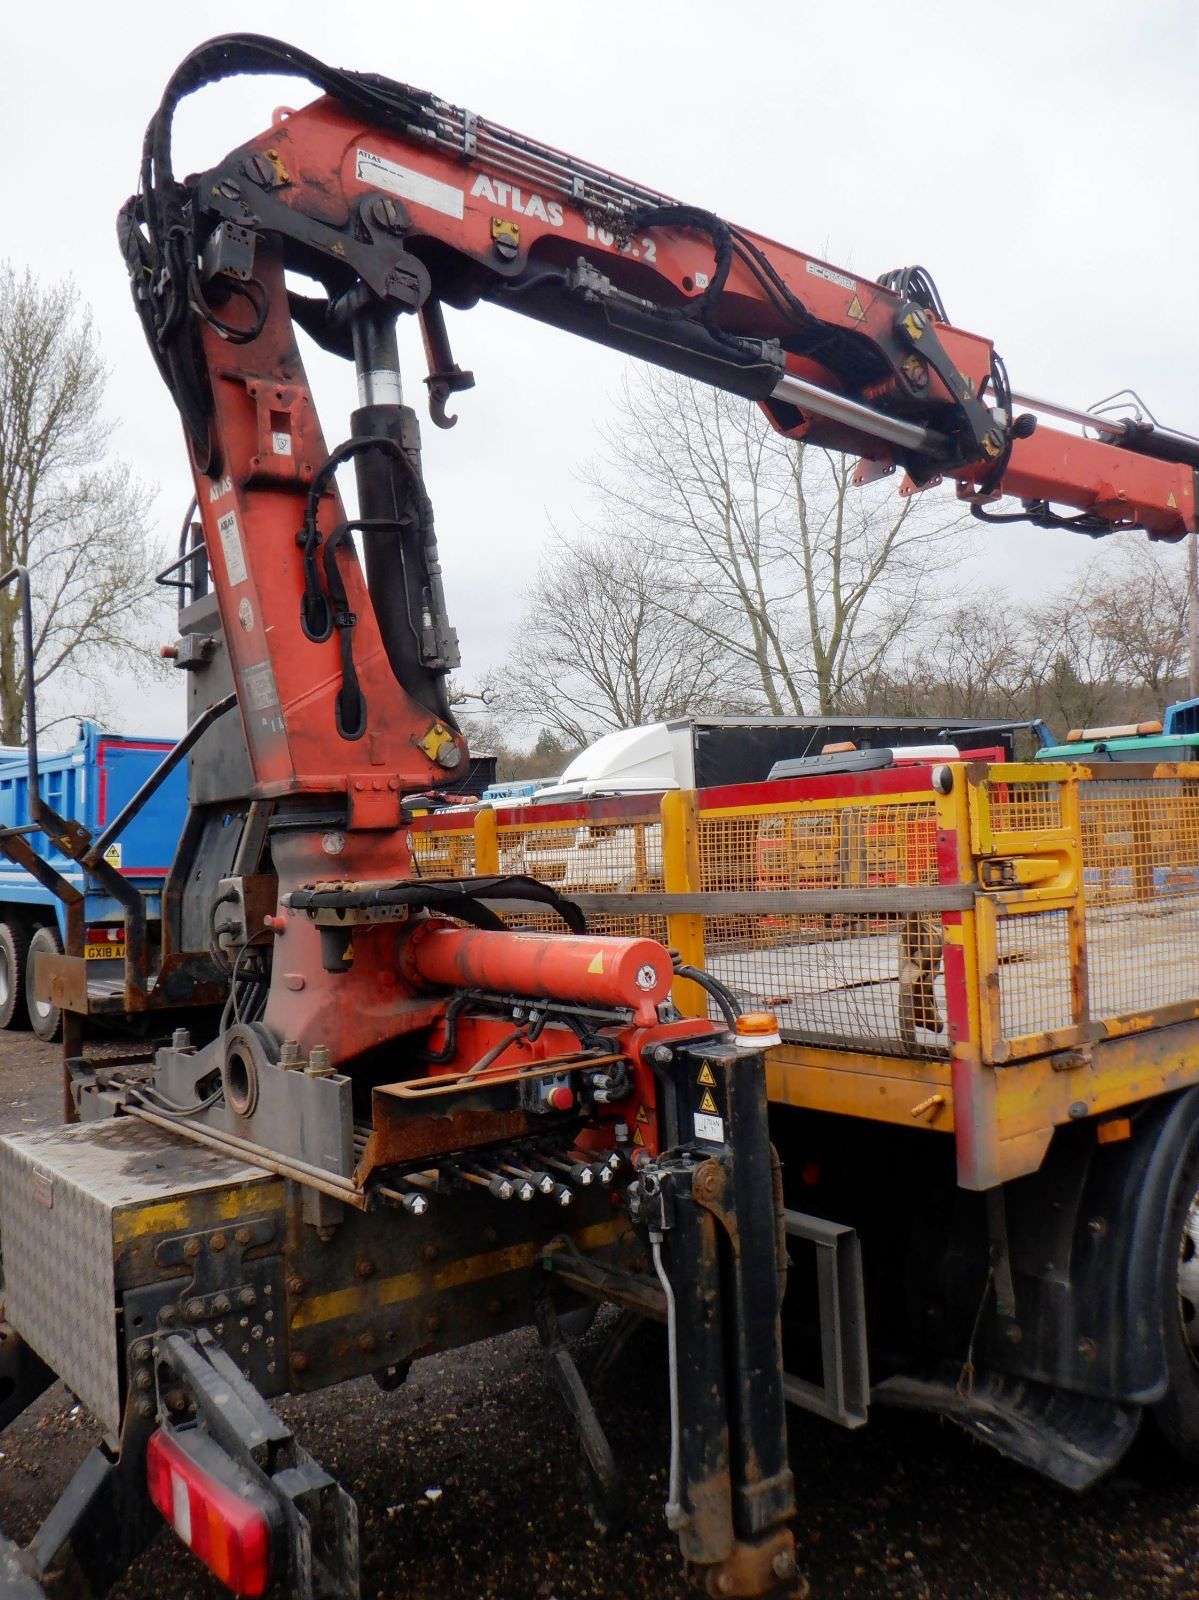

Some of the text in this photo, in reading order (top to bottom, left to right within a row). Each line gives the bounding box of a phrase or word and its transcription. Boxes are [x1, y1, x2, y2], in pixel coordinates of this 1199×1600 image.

[359, 150, 381, 164] ATLAS
[470, 173, 564, 227] ATLAS
[88, 947, 112, 958] GX18
